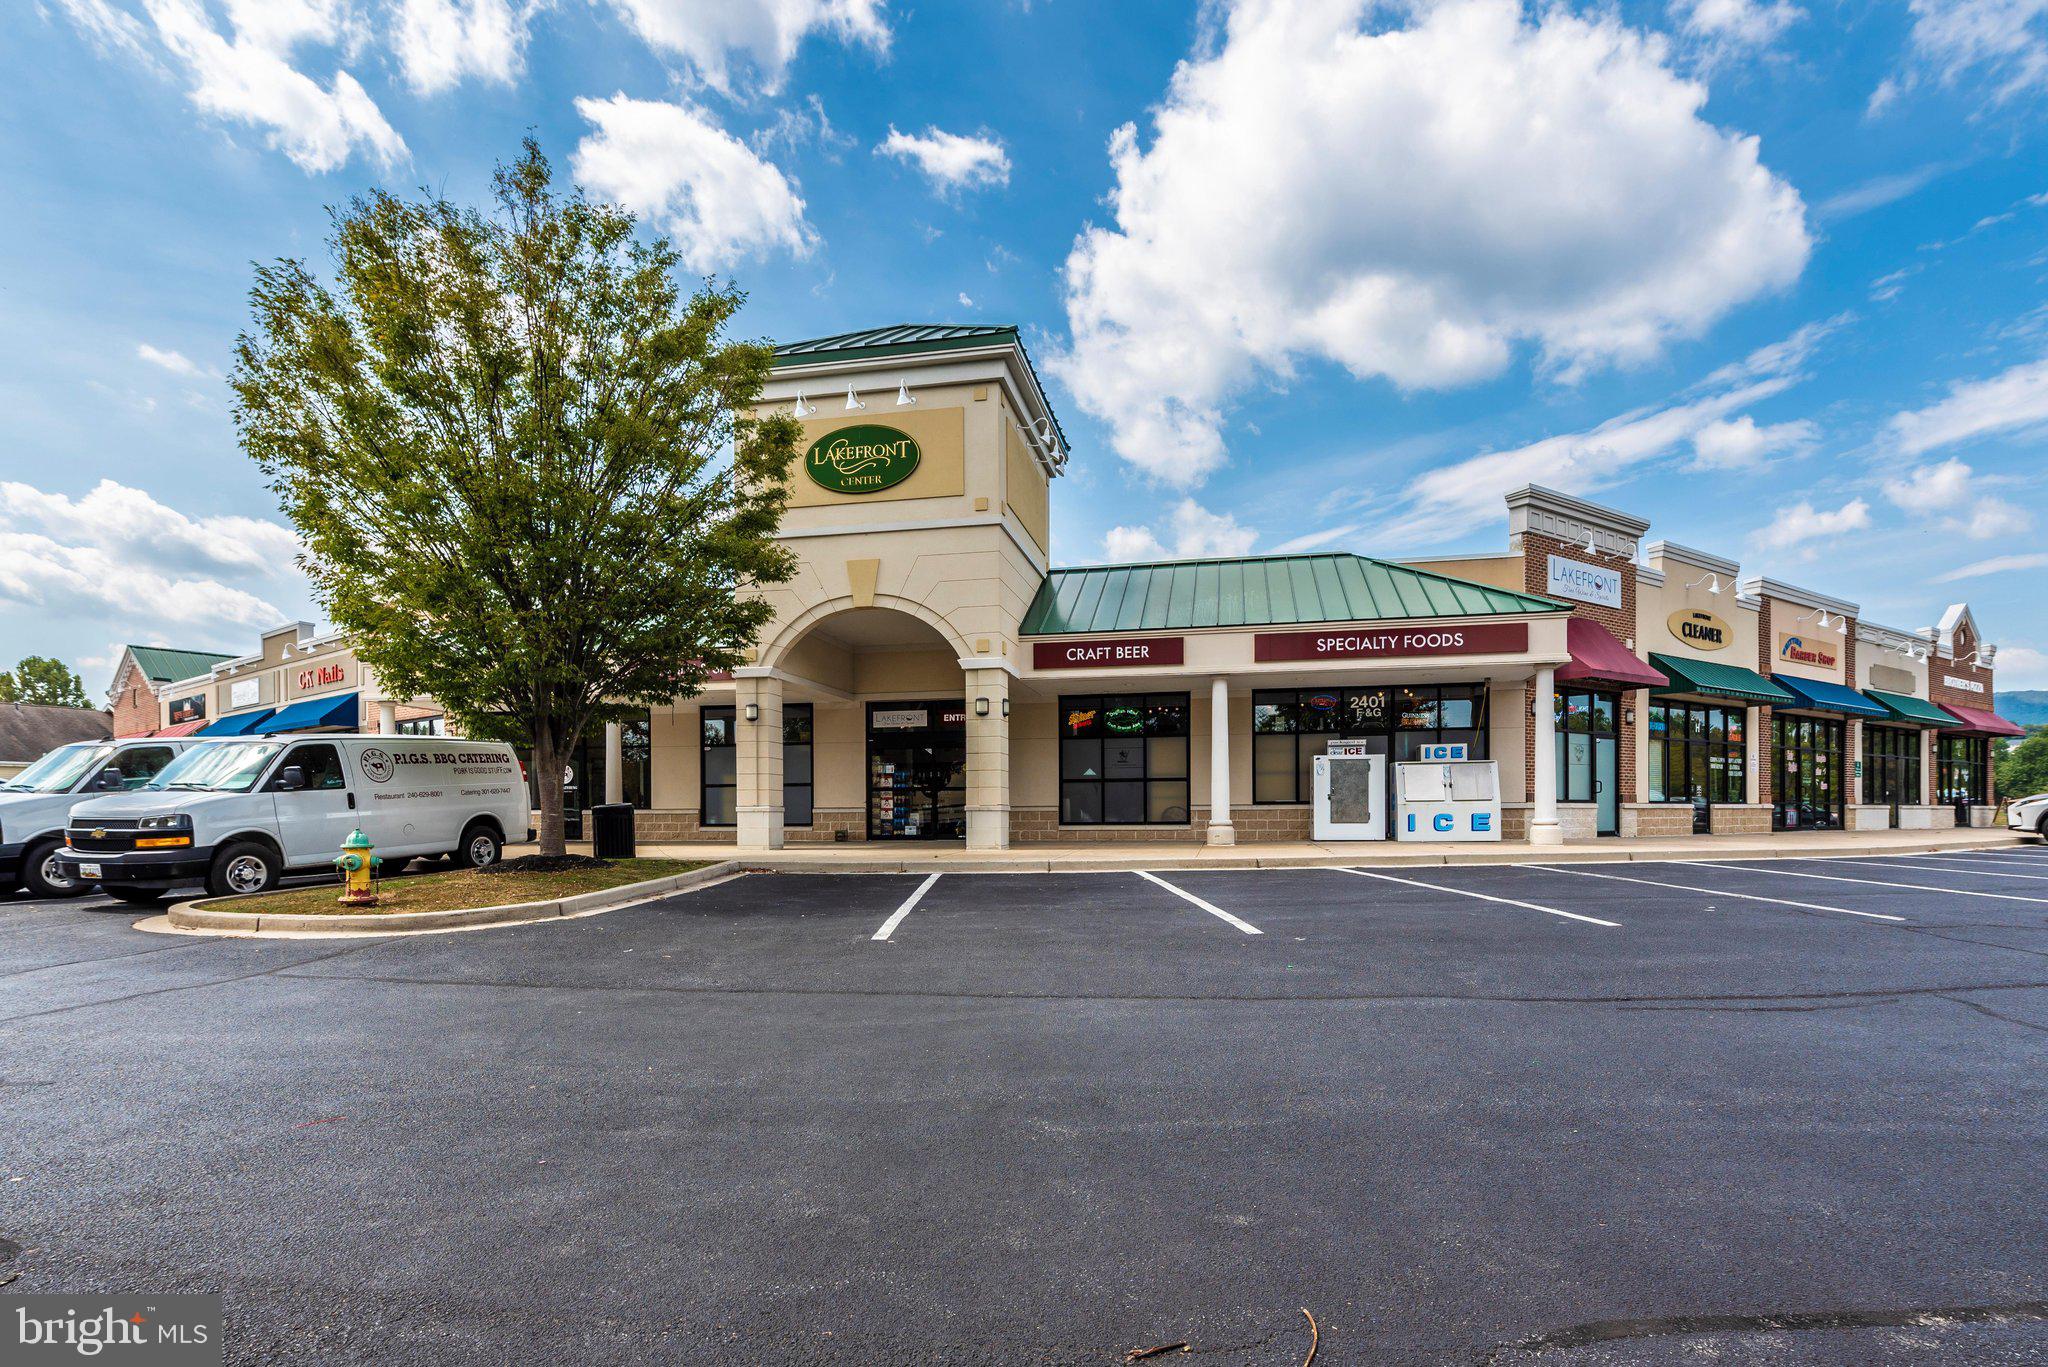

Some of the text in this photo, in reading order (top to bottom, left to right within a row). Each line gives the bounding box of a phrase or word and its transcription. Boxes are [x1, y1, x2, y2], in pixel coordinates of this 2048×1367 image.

[814, 439, 911, 470] LAKEFRONT
[840, 475, 882, 487] CENTER
[1553, 558, 1617, 595] LAKEFRONT
[1682, 621, 1722, 644] CLEANER
[1316, 632, 1464, 652] SPECIALTY FOODS
[1066, 646, 1150, 661] CRAFT BEER
[1818, 651, 1836, 666] SHOP
[299, 664, 345, 690] CK Nails
[1350, 695, 1385, 709] 2401
[876, 713, 924, 722] LAKEFRONT
[1356, 709, 1382, 717] F&G
[1343, 747, 1363, 755] ICE
[1425, 746, 1464, 759] ICE
[393, 753, 510, 765] P.I.G.S. BBQ CATERING
[460, 789, 481, 797] Catering
[1407, 812, 1491, 832] ICE
